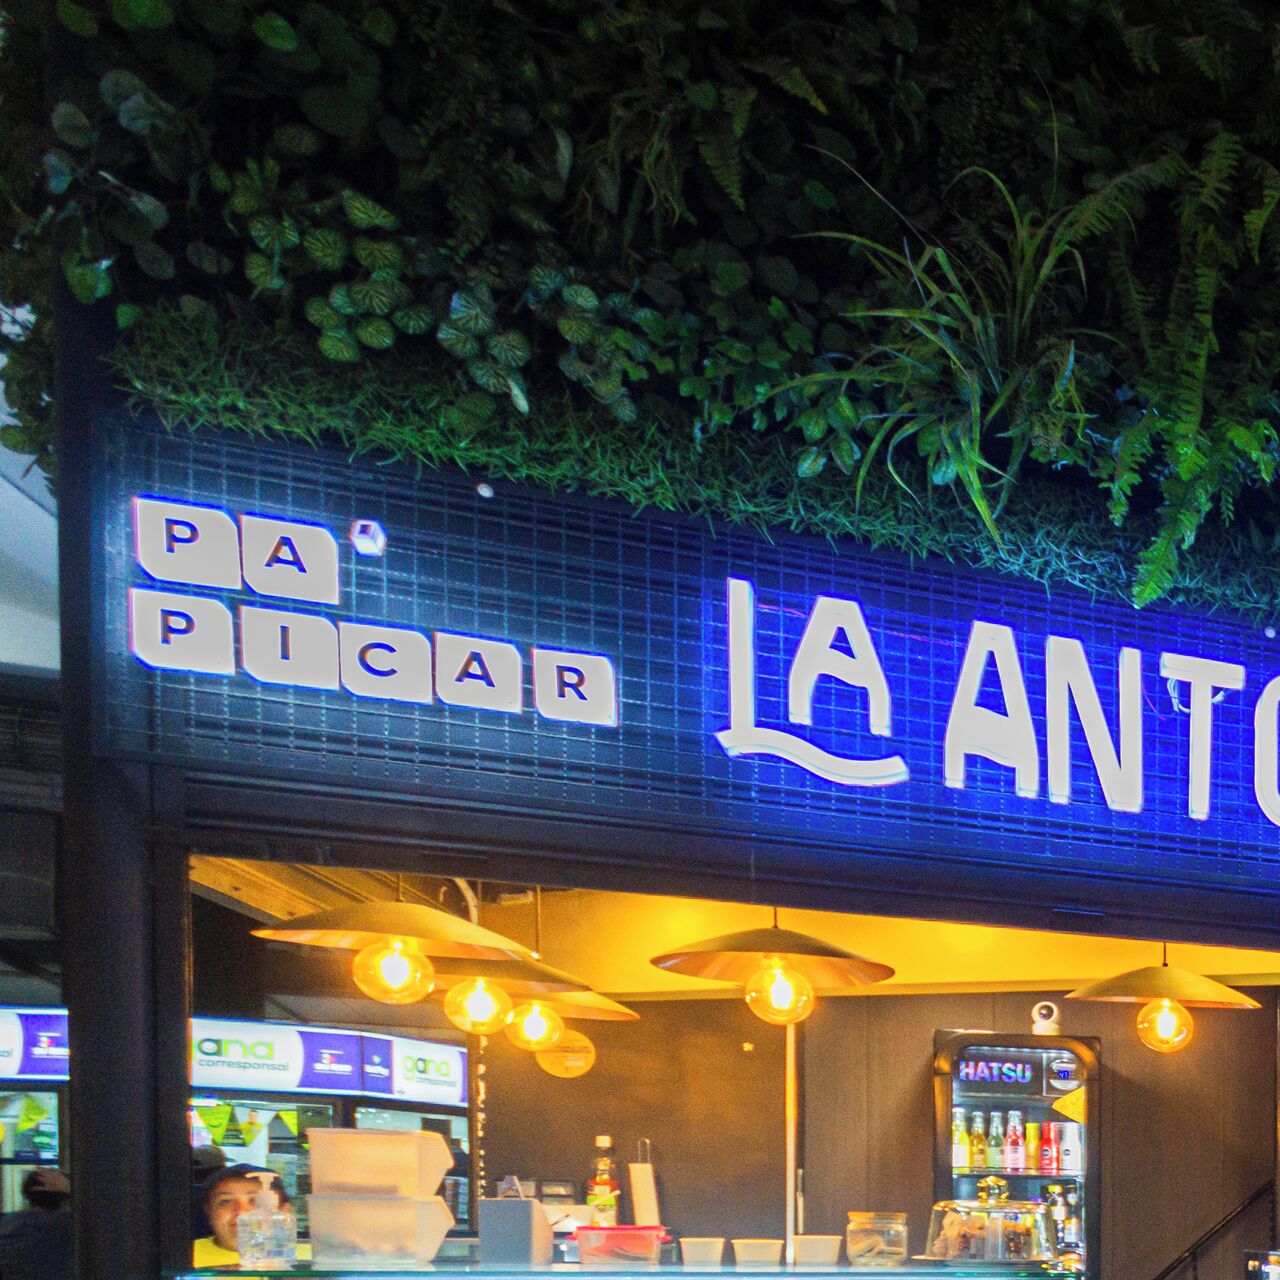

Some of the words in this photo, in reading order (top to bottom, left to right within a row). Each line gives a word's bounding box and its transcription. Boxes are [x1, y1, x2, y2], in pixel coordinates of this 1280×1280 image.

[159, 608, 587, 702] PICAR
[714, 576, 909, 787] LA
[402, 1055, 450, 1082] gana
[959, 1060, 1032, 1084] HATSU
